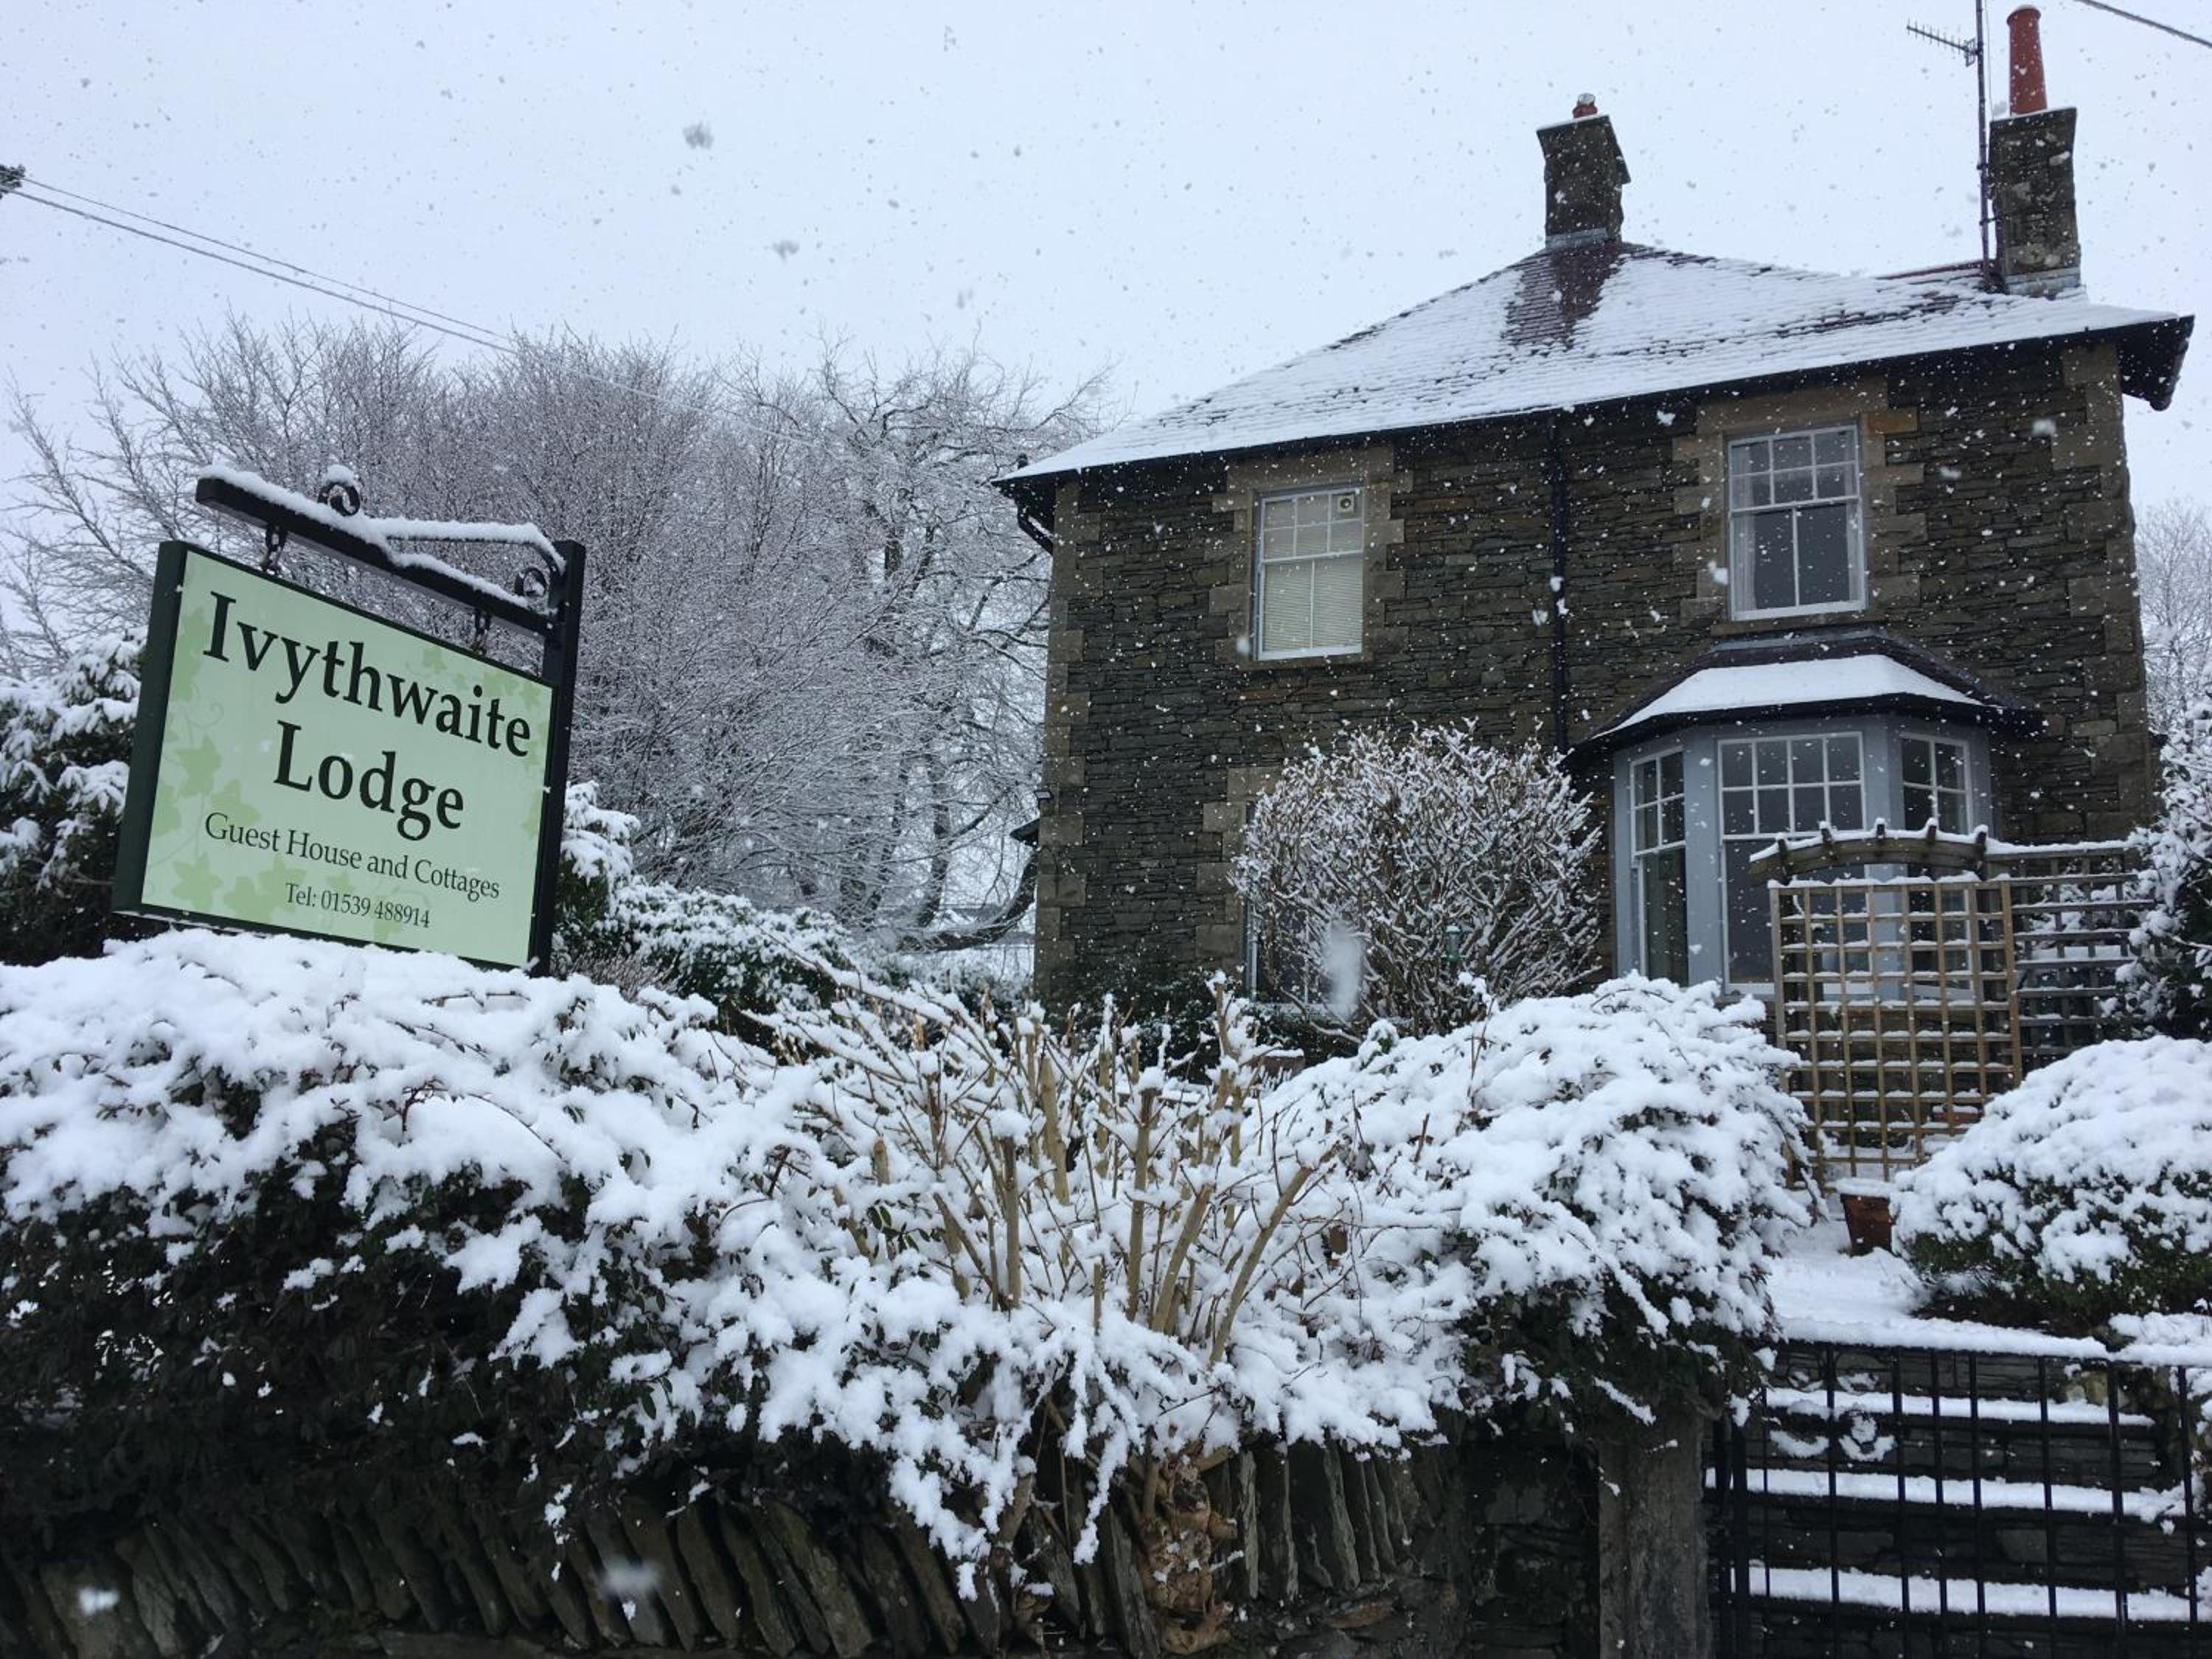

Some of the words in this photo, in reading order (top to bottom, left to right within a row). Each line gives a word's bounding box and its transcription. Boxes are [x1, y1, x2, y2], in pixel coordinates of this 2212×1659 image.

[203, 591, 531, 757] Ivythwaite
[273, 720, 465, 841] Lodge
[205, 812, 280, 852] Guest
[286, 829, 362, 869] House
[366, 855, 408, 880] and
[414, 859, 500, 902] Cottages
[285, 883, 316, 908] Tel:
[321, 890, 371, 917] 01539
[374, 900, 430, 928] 488914
